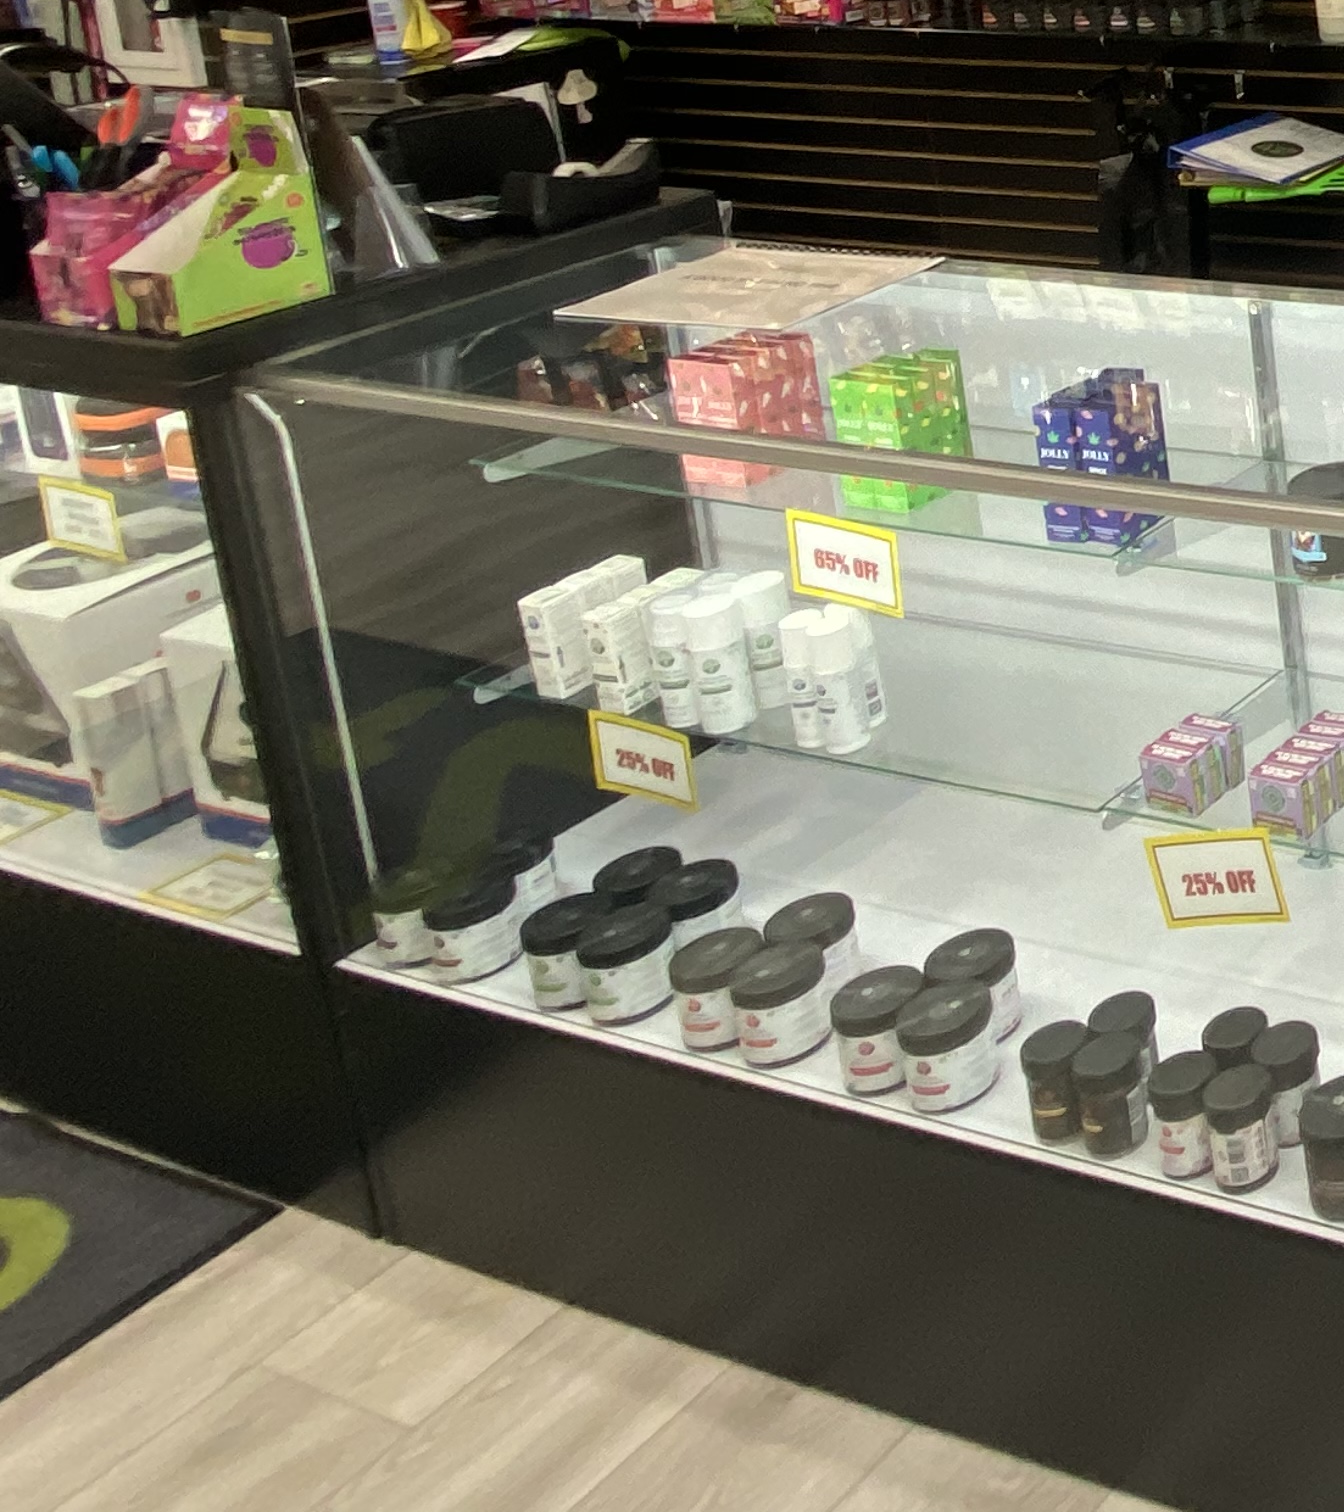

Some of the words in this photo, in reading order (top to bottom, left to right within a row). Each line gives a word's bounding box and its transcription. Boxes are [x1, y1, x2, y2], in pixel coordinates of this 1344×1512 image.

[1040, 448, 1069, 459] JOLLY
[1082, 450, 1110, 461] JOLLY
[814, 548, 850, 575] 65%
[853, 557, 879, 583] OFF
[616, 748, 649, 773] 25%
[652, 757, 675, 781] OFF
[1182, 871, 1225, 896] 25%
[1226, 869, 1256, 893] OFF
